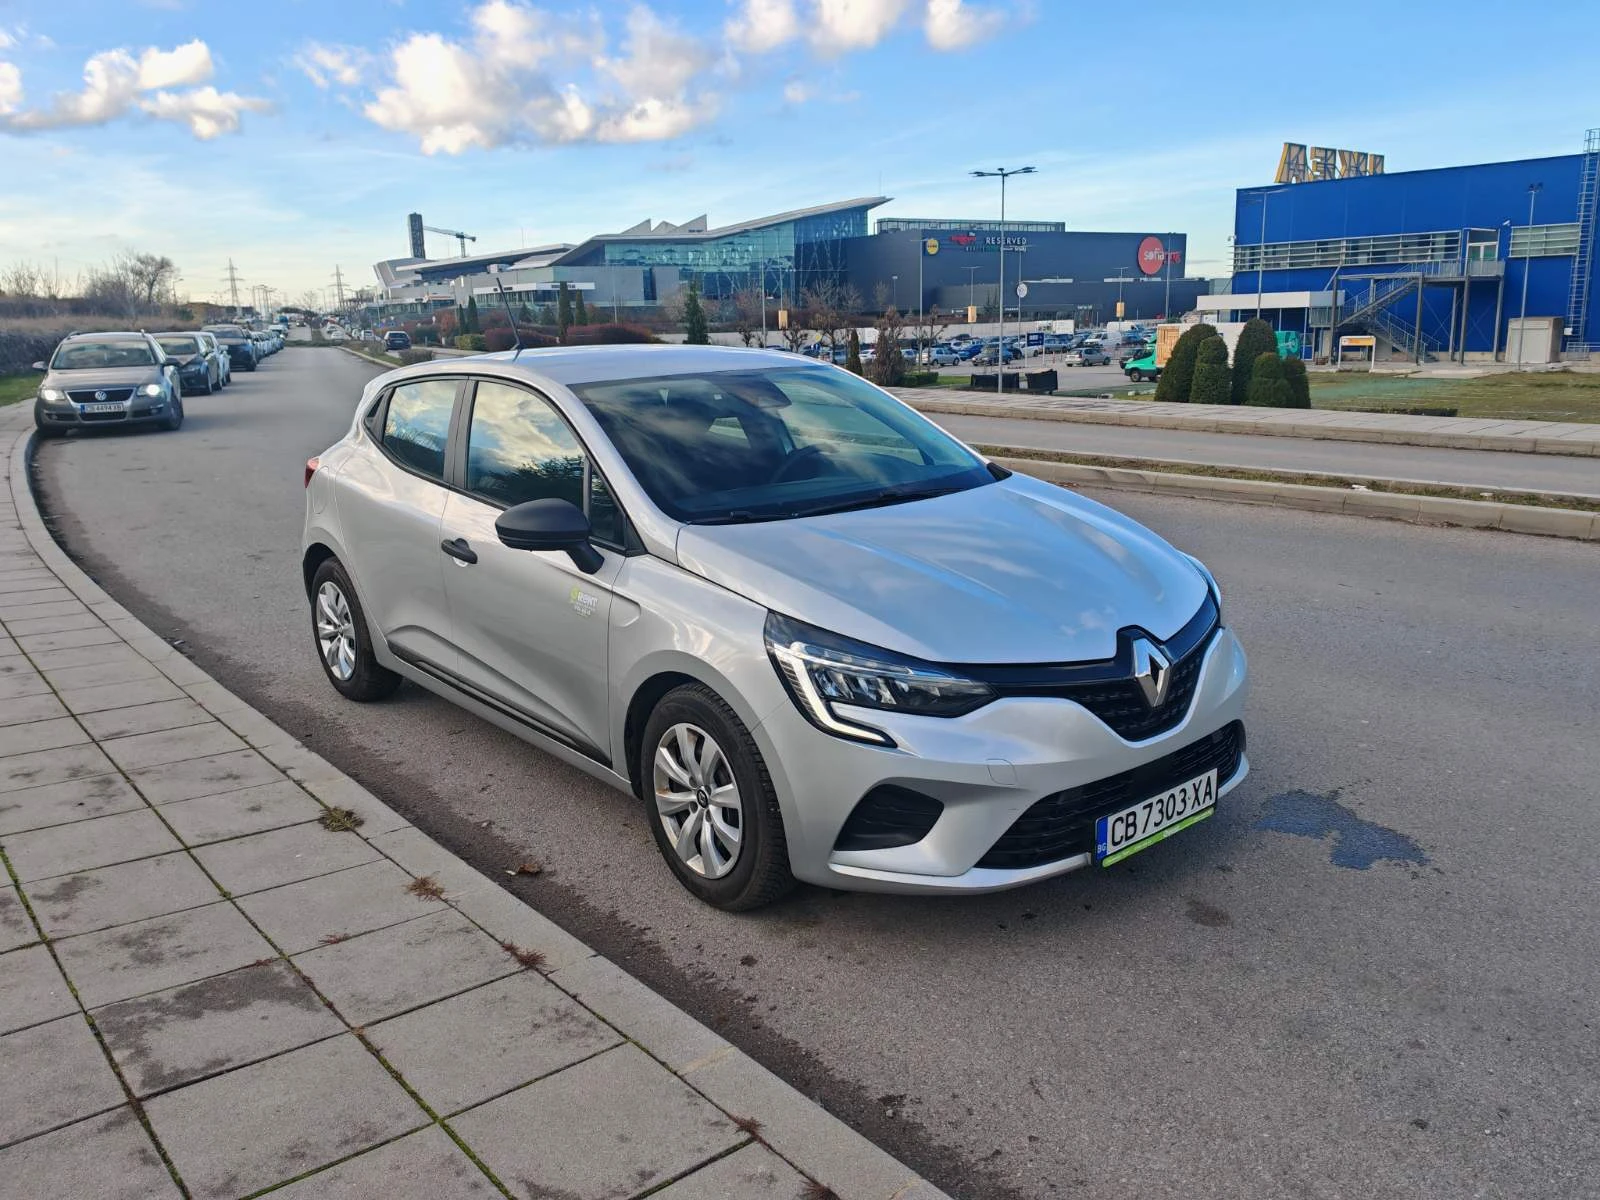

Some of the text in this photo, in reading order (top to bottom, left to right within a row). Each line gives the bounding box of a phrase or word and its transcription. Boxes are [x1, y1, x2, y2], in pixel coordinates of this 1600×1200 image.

[1111, 811, 1137, 847] CB
[1142, 788, 1187, 834] 7303
[1191, 776, 1213, 810] XA
[1097, 842, 1107, 854] BG
